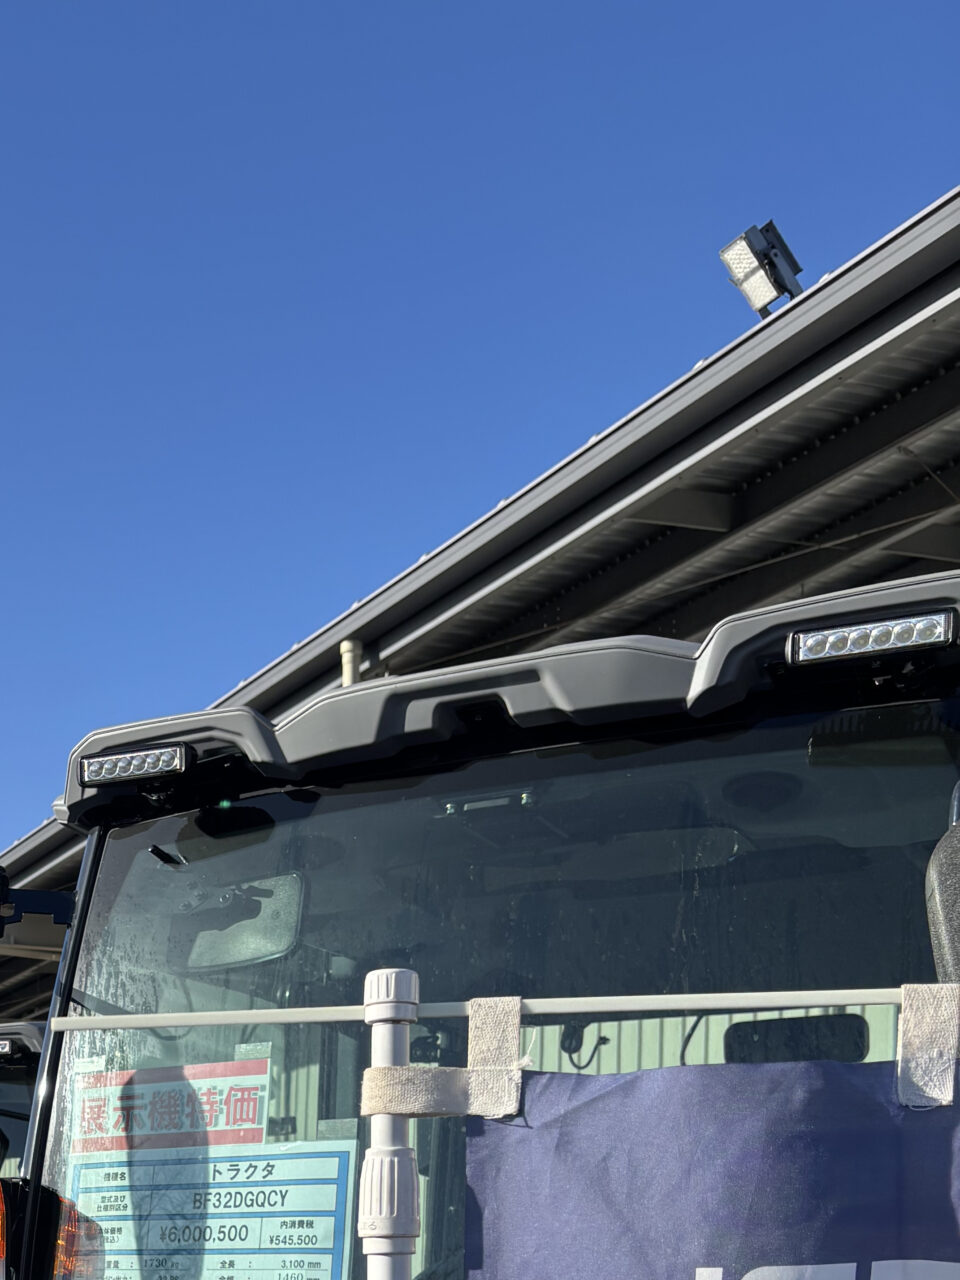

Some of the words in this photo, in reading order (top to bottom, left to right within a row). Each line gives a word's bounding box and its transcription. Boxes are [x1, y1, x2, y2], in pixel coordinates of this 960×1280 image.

[79, 1085, 260, 1135] 展示機特価
[211, 1161, 276, 1181] トラクタ
[192, 1189, 289, 1210] BF32DGQCY
[159, 1224, 249, 1244] ¥6,000,500
[279, 1219, 314, 1230] 内消費税
[269, 1234, 318, 1246] ¥545,500
[280, 1259, 305, 1269] 3,100
[307, 1261, 321, 1269] mm
